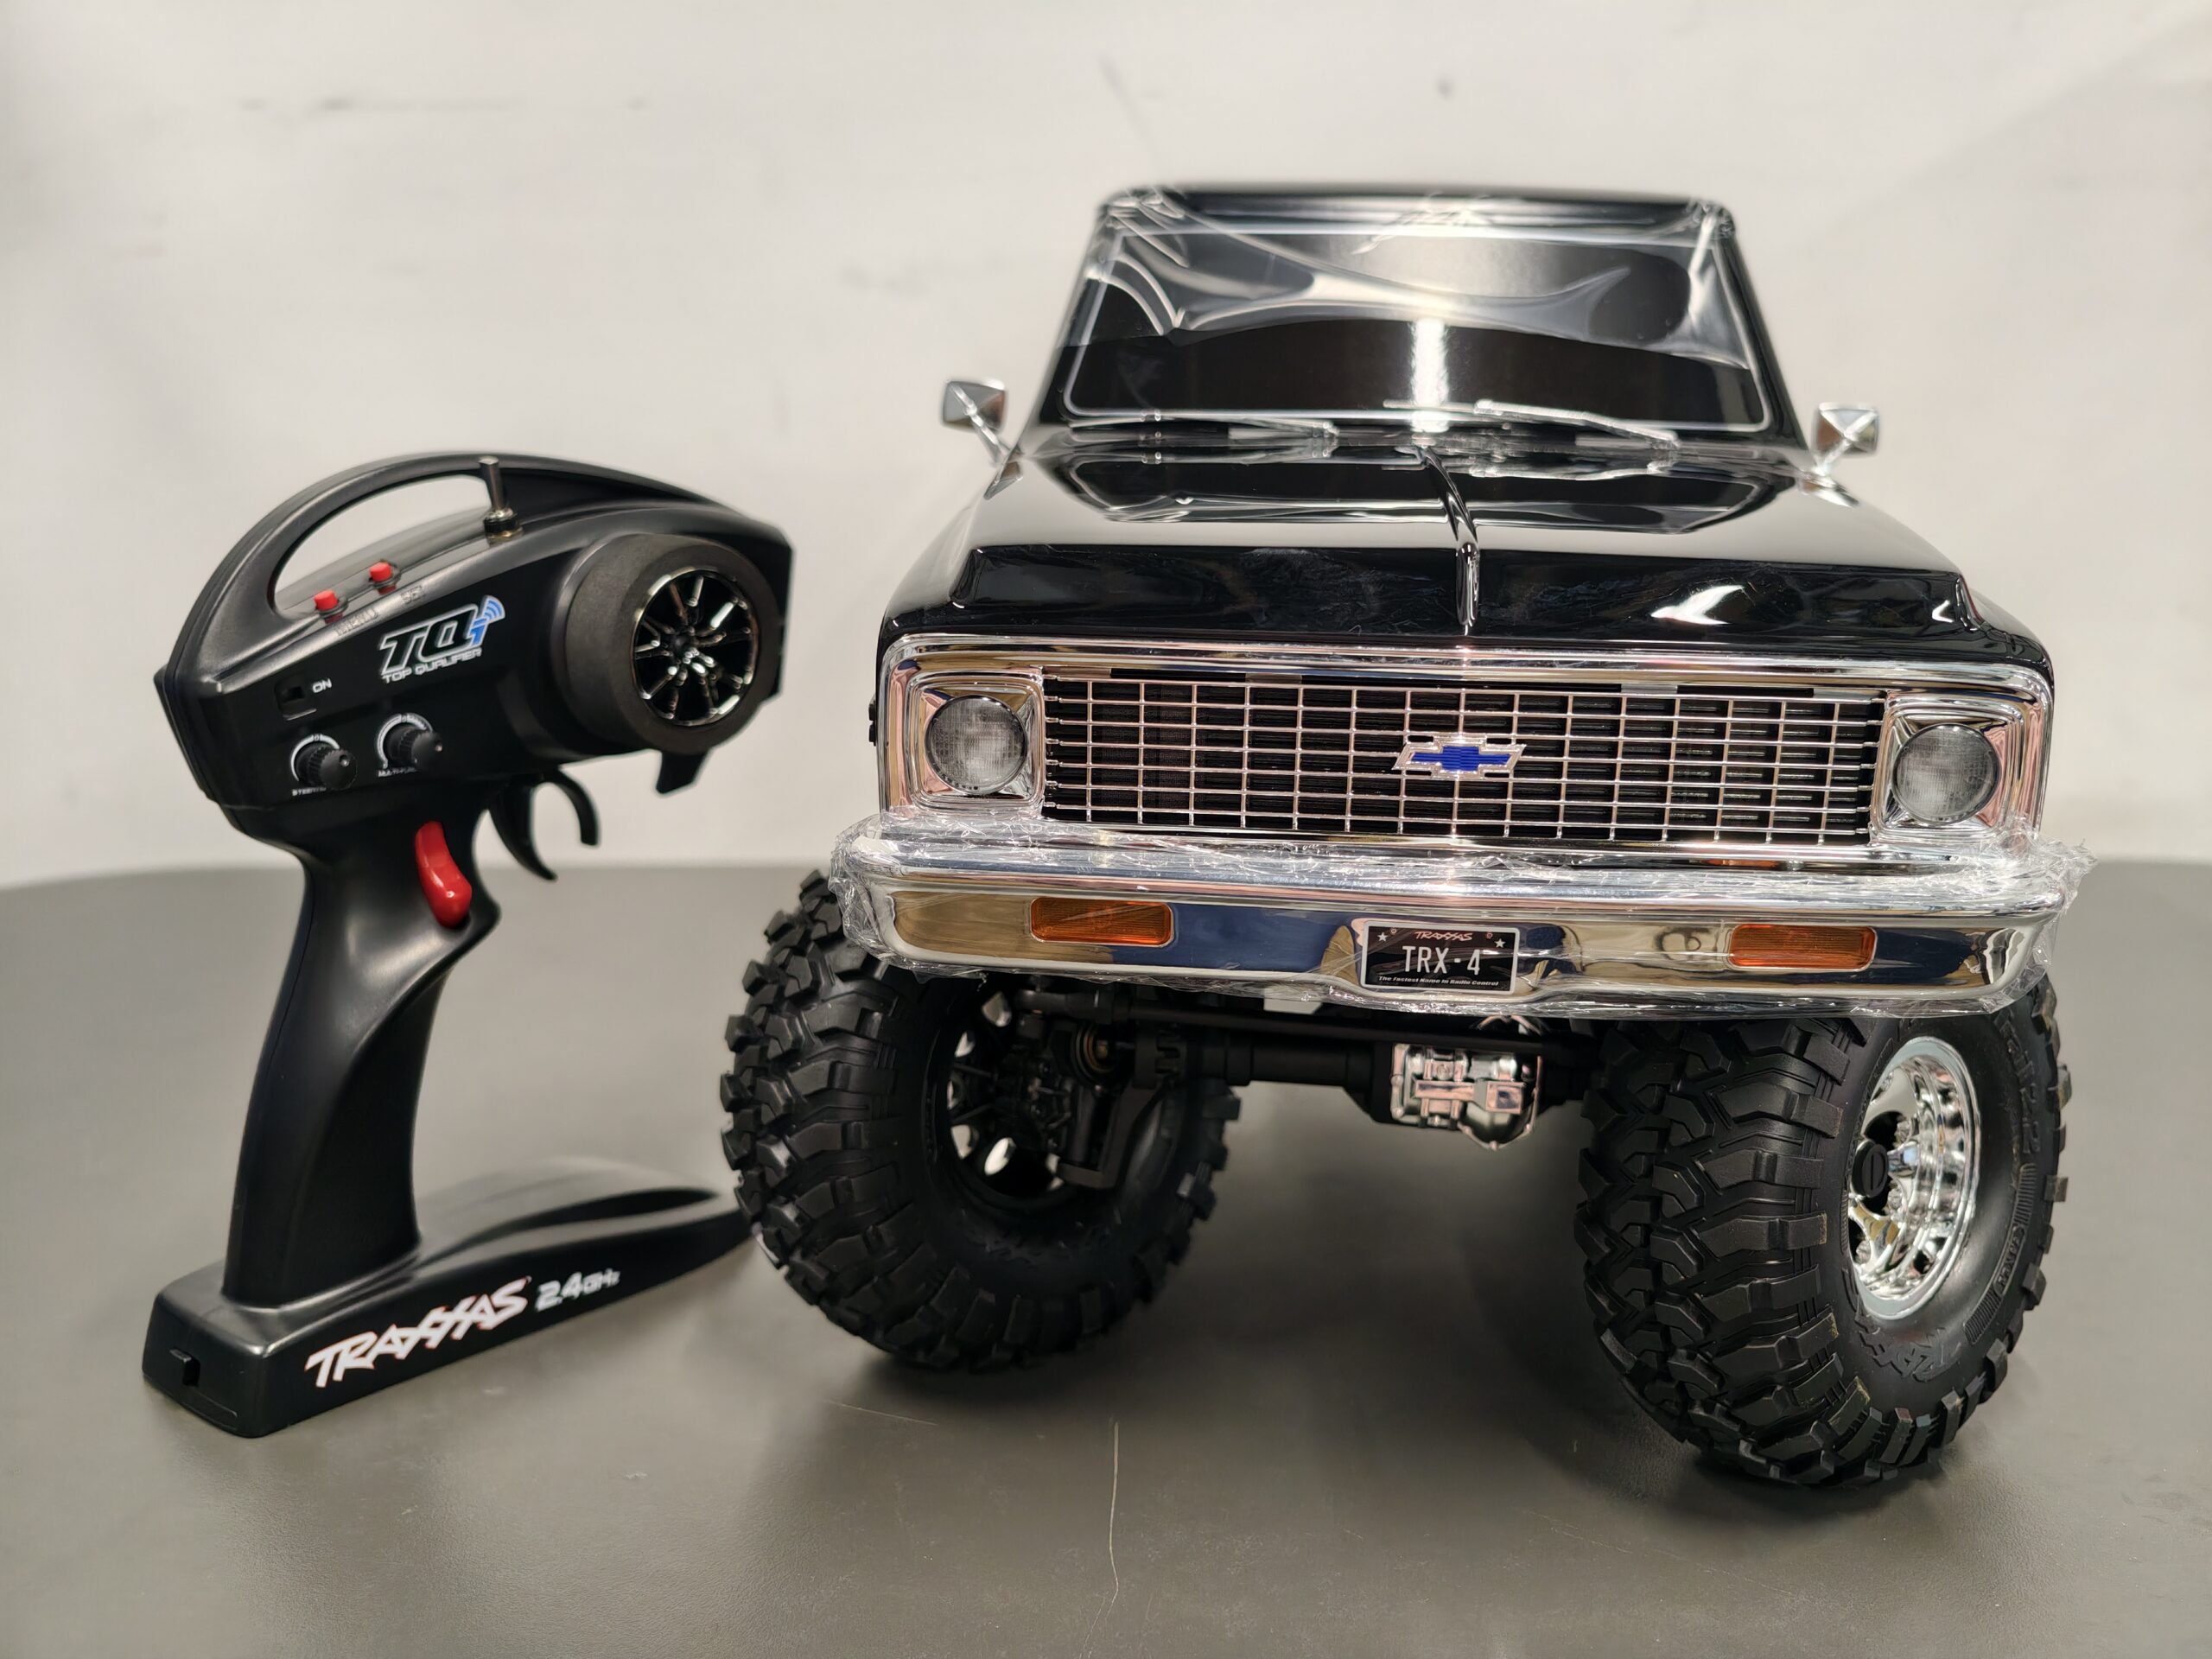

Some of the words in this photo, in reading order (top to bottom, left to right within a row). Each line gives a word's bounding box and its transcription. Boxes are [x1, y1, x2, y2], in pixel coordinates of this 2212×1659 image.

[382, 666, 413, 683] TOP
[415, 647, 483, 675] QUALIFIER
[312, 677, 333, 693] ON
[1414, 931, 1473, 942] TRAXXAS
[304, 1275, 532, 1389] TRAXXAS
